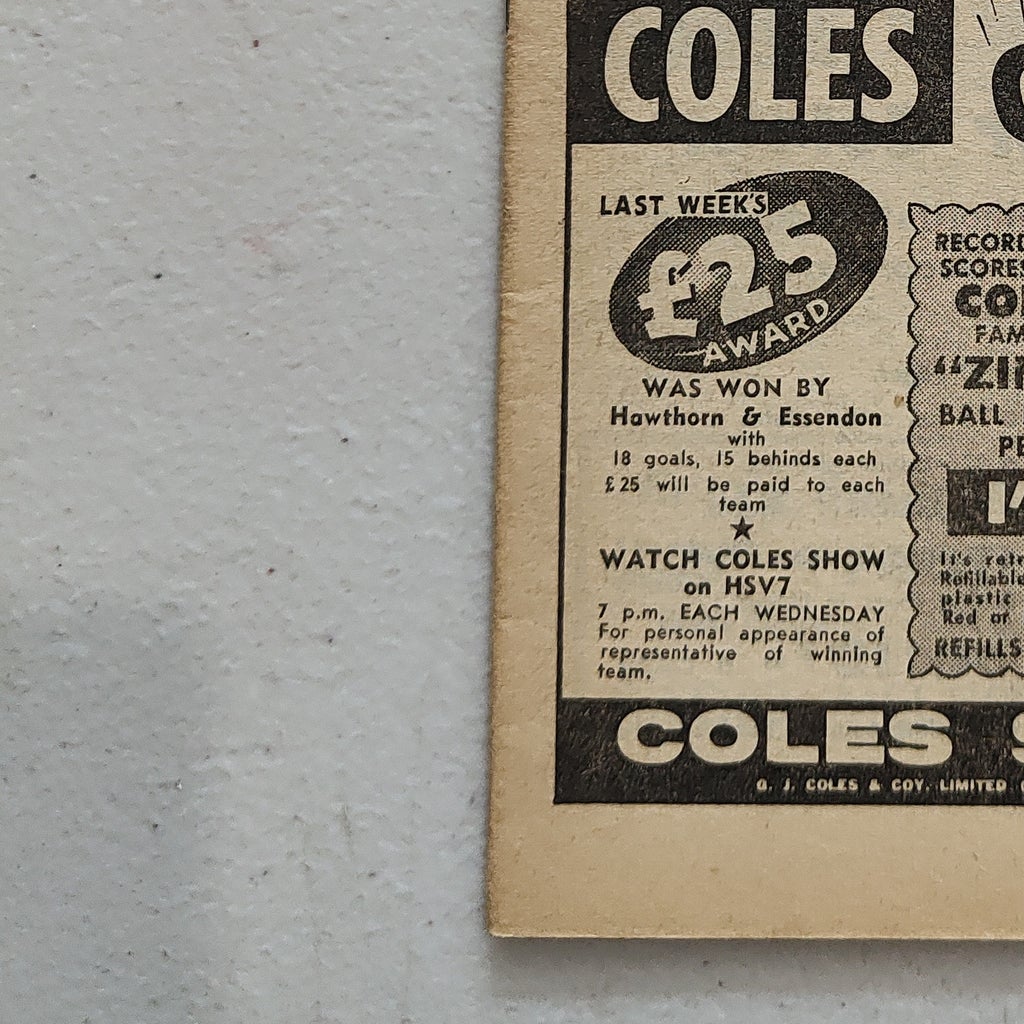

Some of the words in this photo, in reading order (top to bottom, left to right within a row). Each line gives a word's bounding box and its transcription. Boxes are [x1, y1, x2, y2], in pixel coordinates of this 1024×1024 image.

[604, 5, 919, 124] COLES
[600, 195, 664, 215] LAST
[678, 193, 768, 215] WEEK'S
[637, 199, 838, 339] £25
[701, 298, 831, 368] AWARD
[642, 377, 702, 398] WAS
[717, 378, 781, 397] WON
[797, 377, 831, 397] BY
[610, 406, 724, 426] Hawthorn
[742, 406, 762, 426] &
[779, 406, 882, 426] Essendon
[939, 403, 1004, 426] BALL
[727, 430, 766, 446] with
[613, 451, 632, 465] 18
[644, 450, 701, 469] goals,
[716, 451, 735, 466] 15
[748, 451, 821, 466] behinds
[833, 450, 877, 467] each
[657, 477, 689, 492] will
[707, 478, 730, 492] be
[747, 478, 790, 495] paid
[806, 480, 825, 492] to
[841, 480, 885, 493] each
[719, 497, 766, 513] team
[600, 548, 699, 570] WATCH
[715, 549, 794, 570] COLES
[807, 549, 886, 571] SHOW
[683, 580, 711, 596] on
[724, 576, 792, 596] HSV7
[941, 588, 1012, 607] plastic
[597, 603, 609, 619] 7
[622, 606, 665, 622] p.m.
[680, 604, 739, 620] EACH
[754, 605, 885, 623] WEDNESDAY
[943, 608, 977, 625] Red
[990, 612, 1009, 625] or
[599, 623, 629, 641] For
[644, 625, 724, 643] personal
[739, 628, 851, 644] appearance
[866, 627, 886, 643] of
[600, 644, 737, 665] representative
[764, 646, 785, 661] of
[811, 646, 883, 666] winning
[935, 636, 1023, 659] REFILLS
[597, 665, 652, 680] team.
[616, 708, 953, 768] COLES
[805, 779, 859, 791] COLES
[939, 779, 1007, 792] LIMITED
